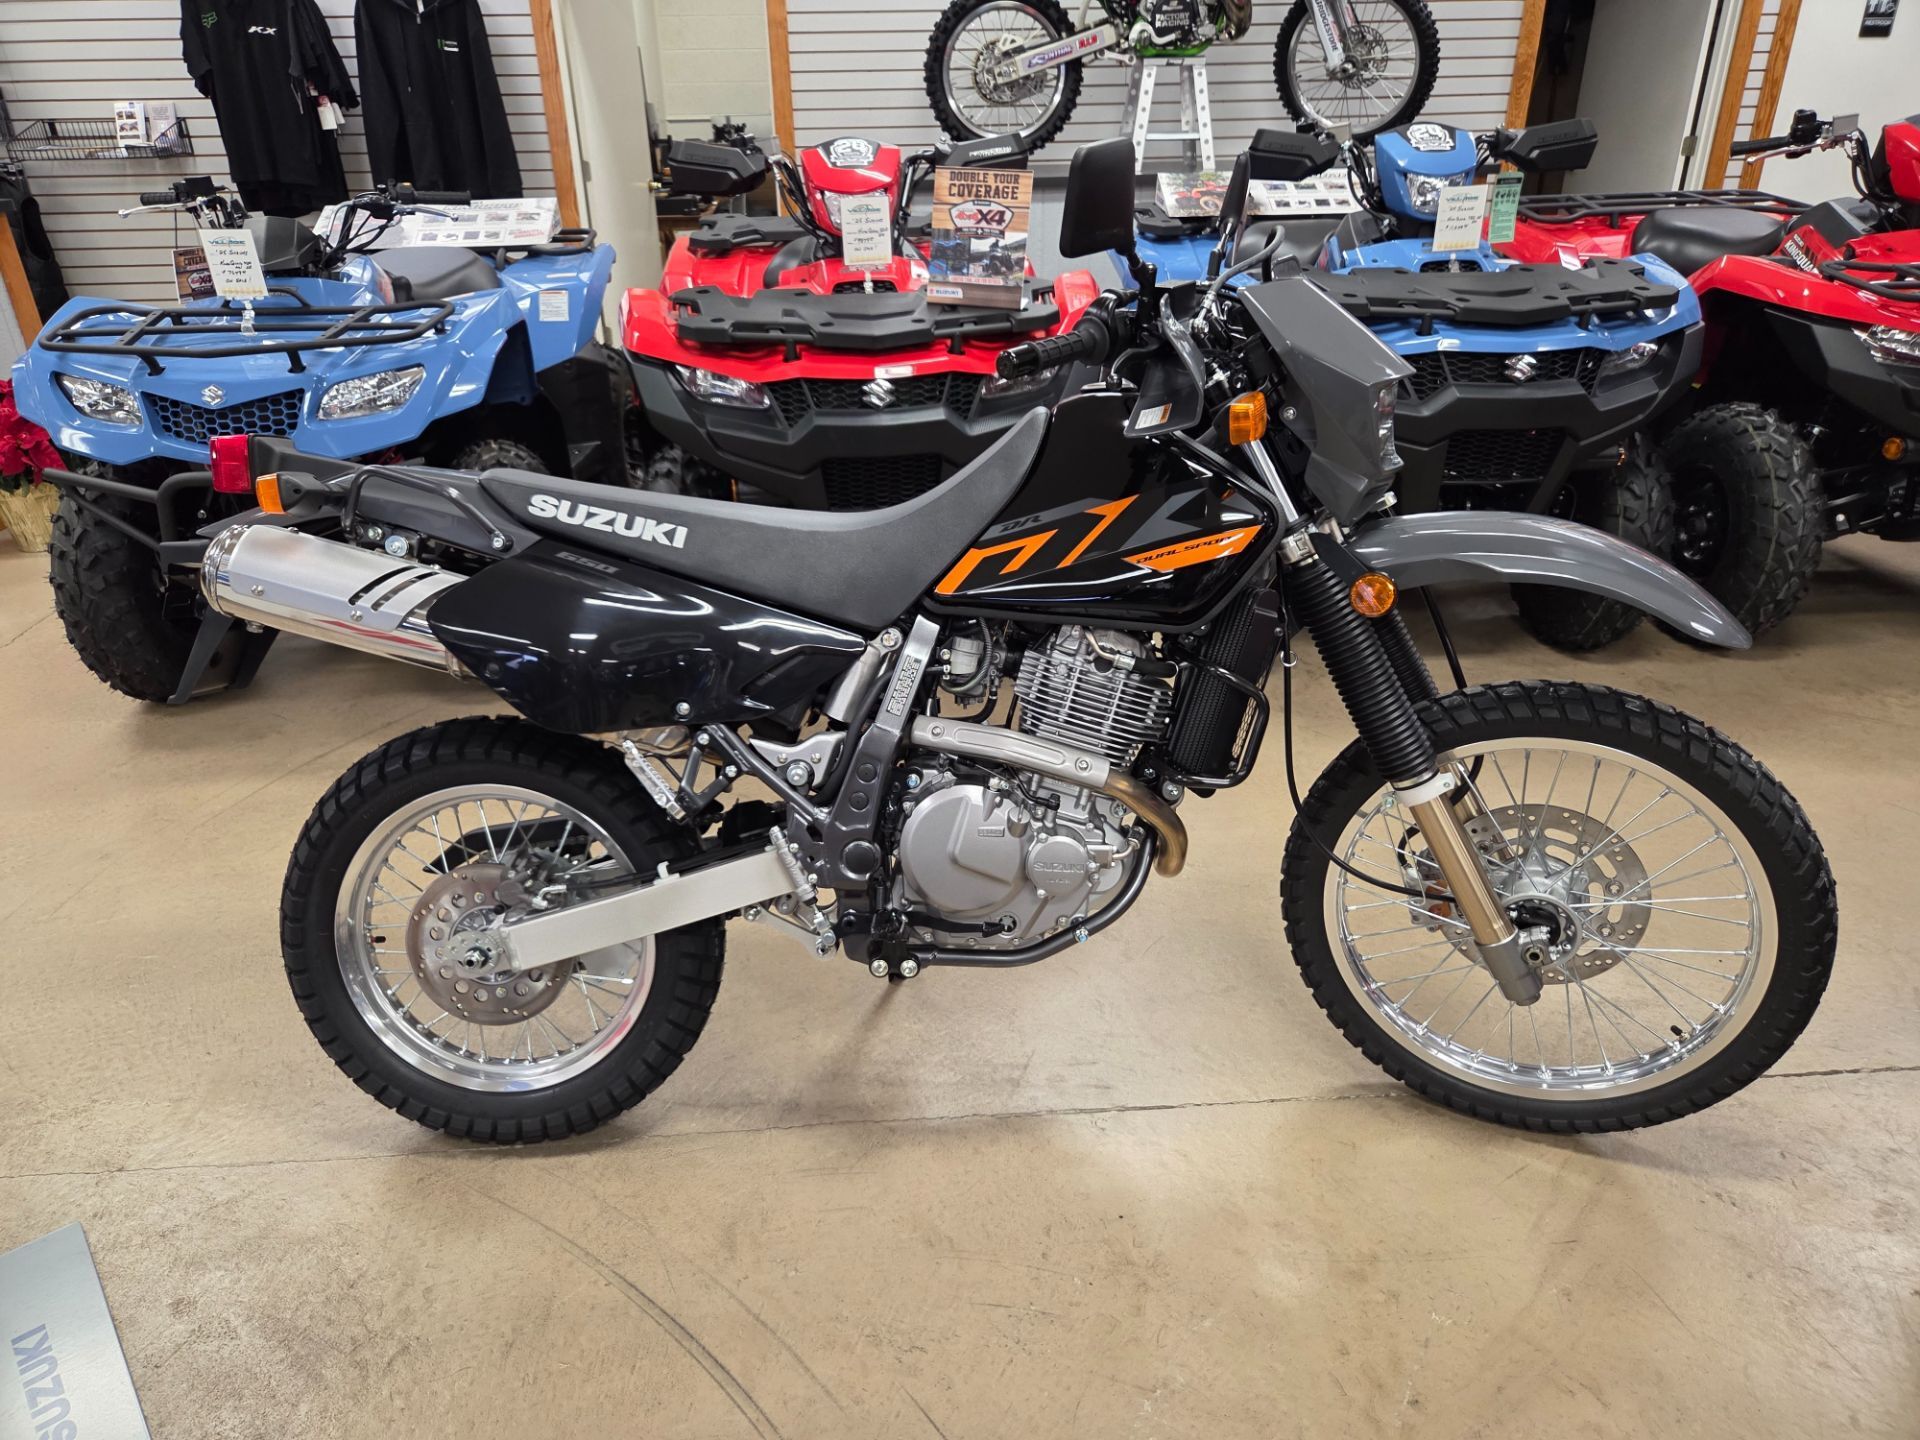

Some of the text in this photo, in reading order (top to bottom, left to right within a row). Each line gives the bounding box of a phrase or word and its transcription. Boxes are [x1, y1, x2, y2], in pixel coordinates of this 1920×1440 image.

[1156, 12, 1190, 20] FACTORY
[1156, 19, 1190, 28] RACING
[248, 26, 278, 35] KX
[949, 171, 1020, 185] DOUBLE YOUR
[948, 183, 1019, 200] COVERAGE
[528, 494, 688, 549] SUZUKI
[1136, 549, 1181, 564] DUAL
[1033, 862, 1085, 873] SUZUKI
